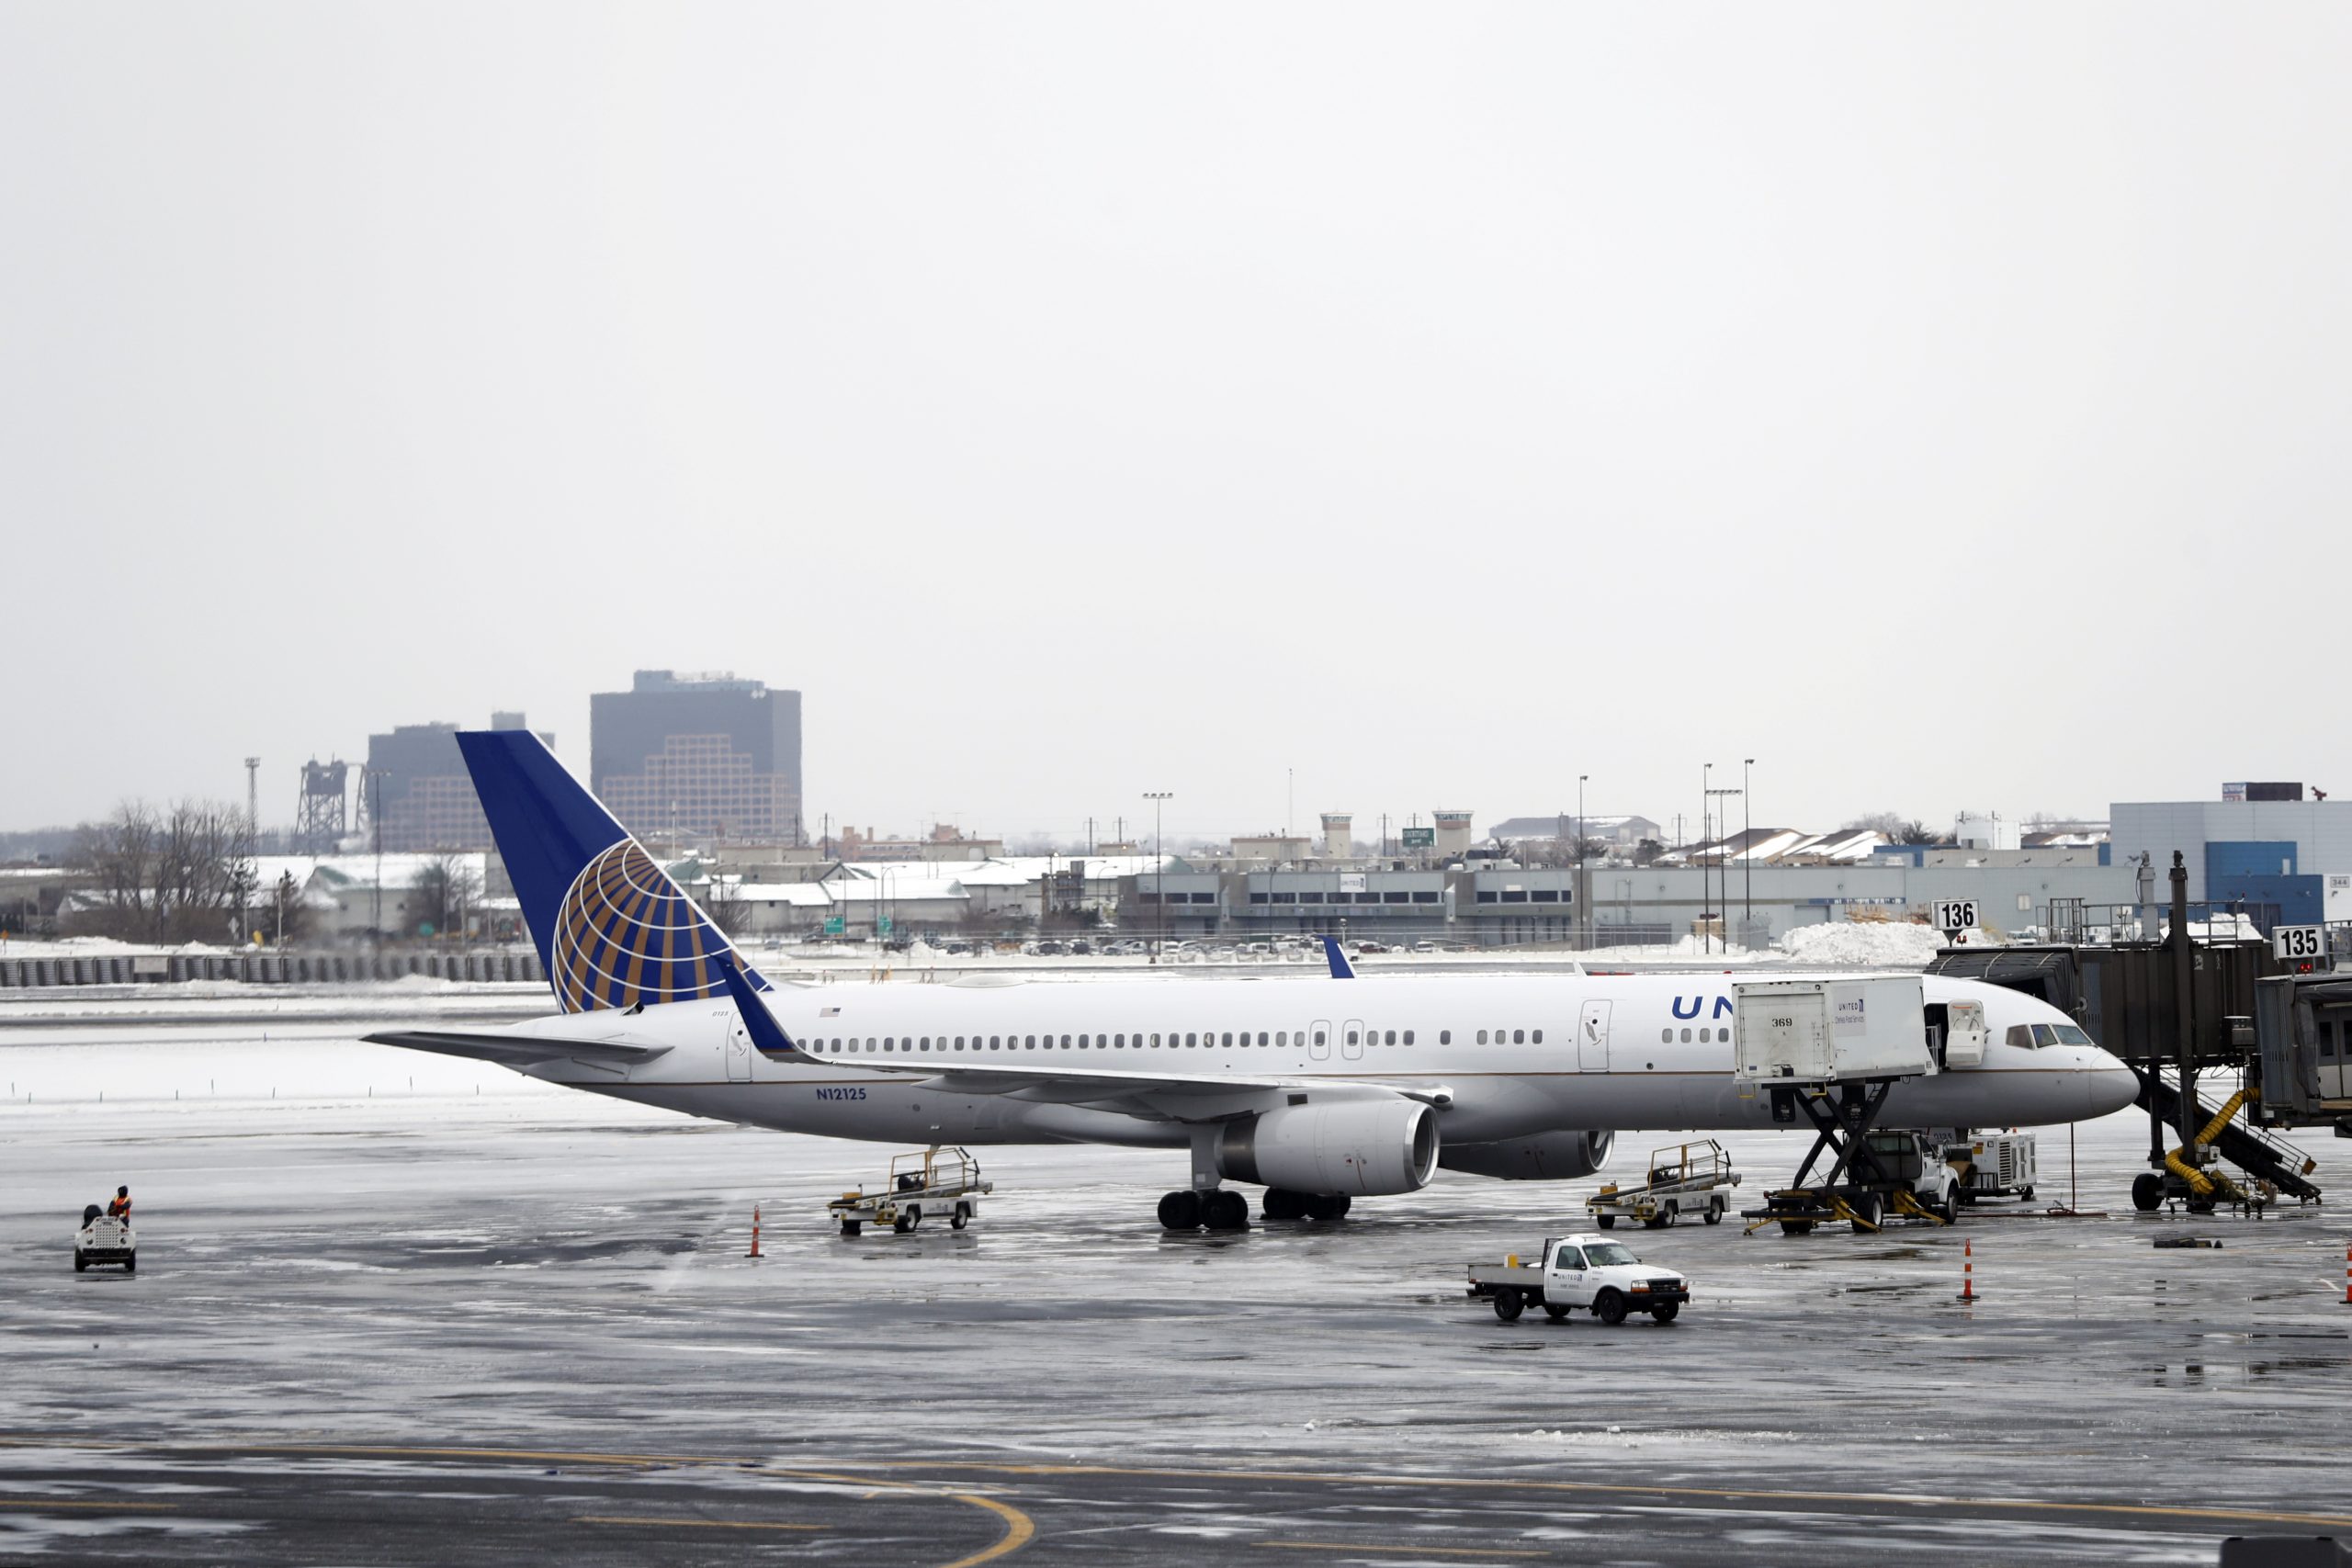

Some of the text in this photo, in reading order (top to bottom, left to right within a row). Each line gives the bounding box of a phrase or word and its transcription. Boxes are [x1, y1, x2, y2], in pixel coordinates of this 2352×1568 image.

[1941, 902, 1973, 928] 136
[2281, 929, 2318, 955] 135
[1838, 1002, 1858, 1010] UNITED
[1771, 1018, 1792, 1027] 369
[816, 1088, 866, 1100] N12125
